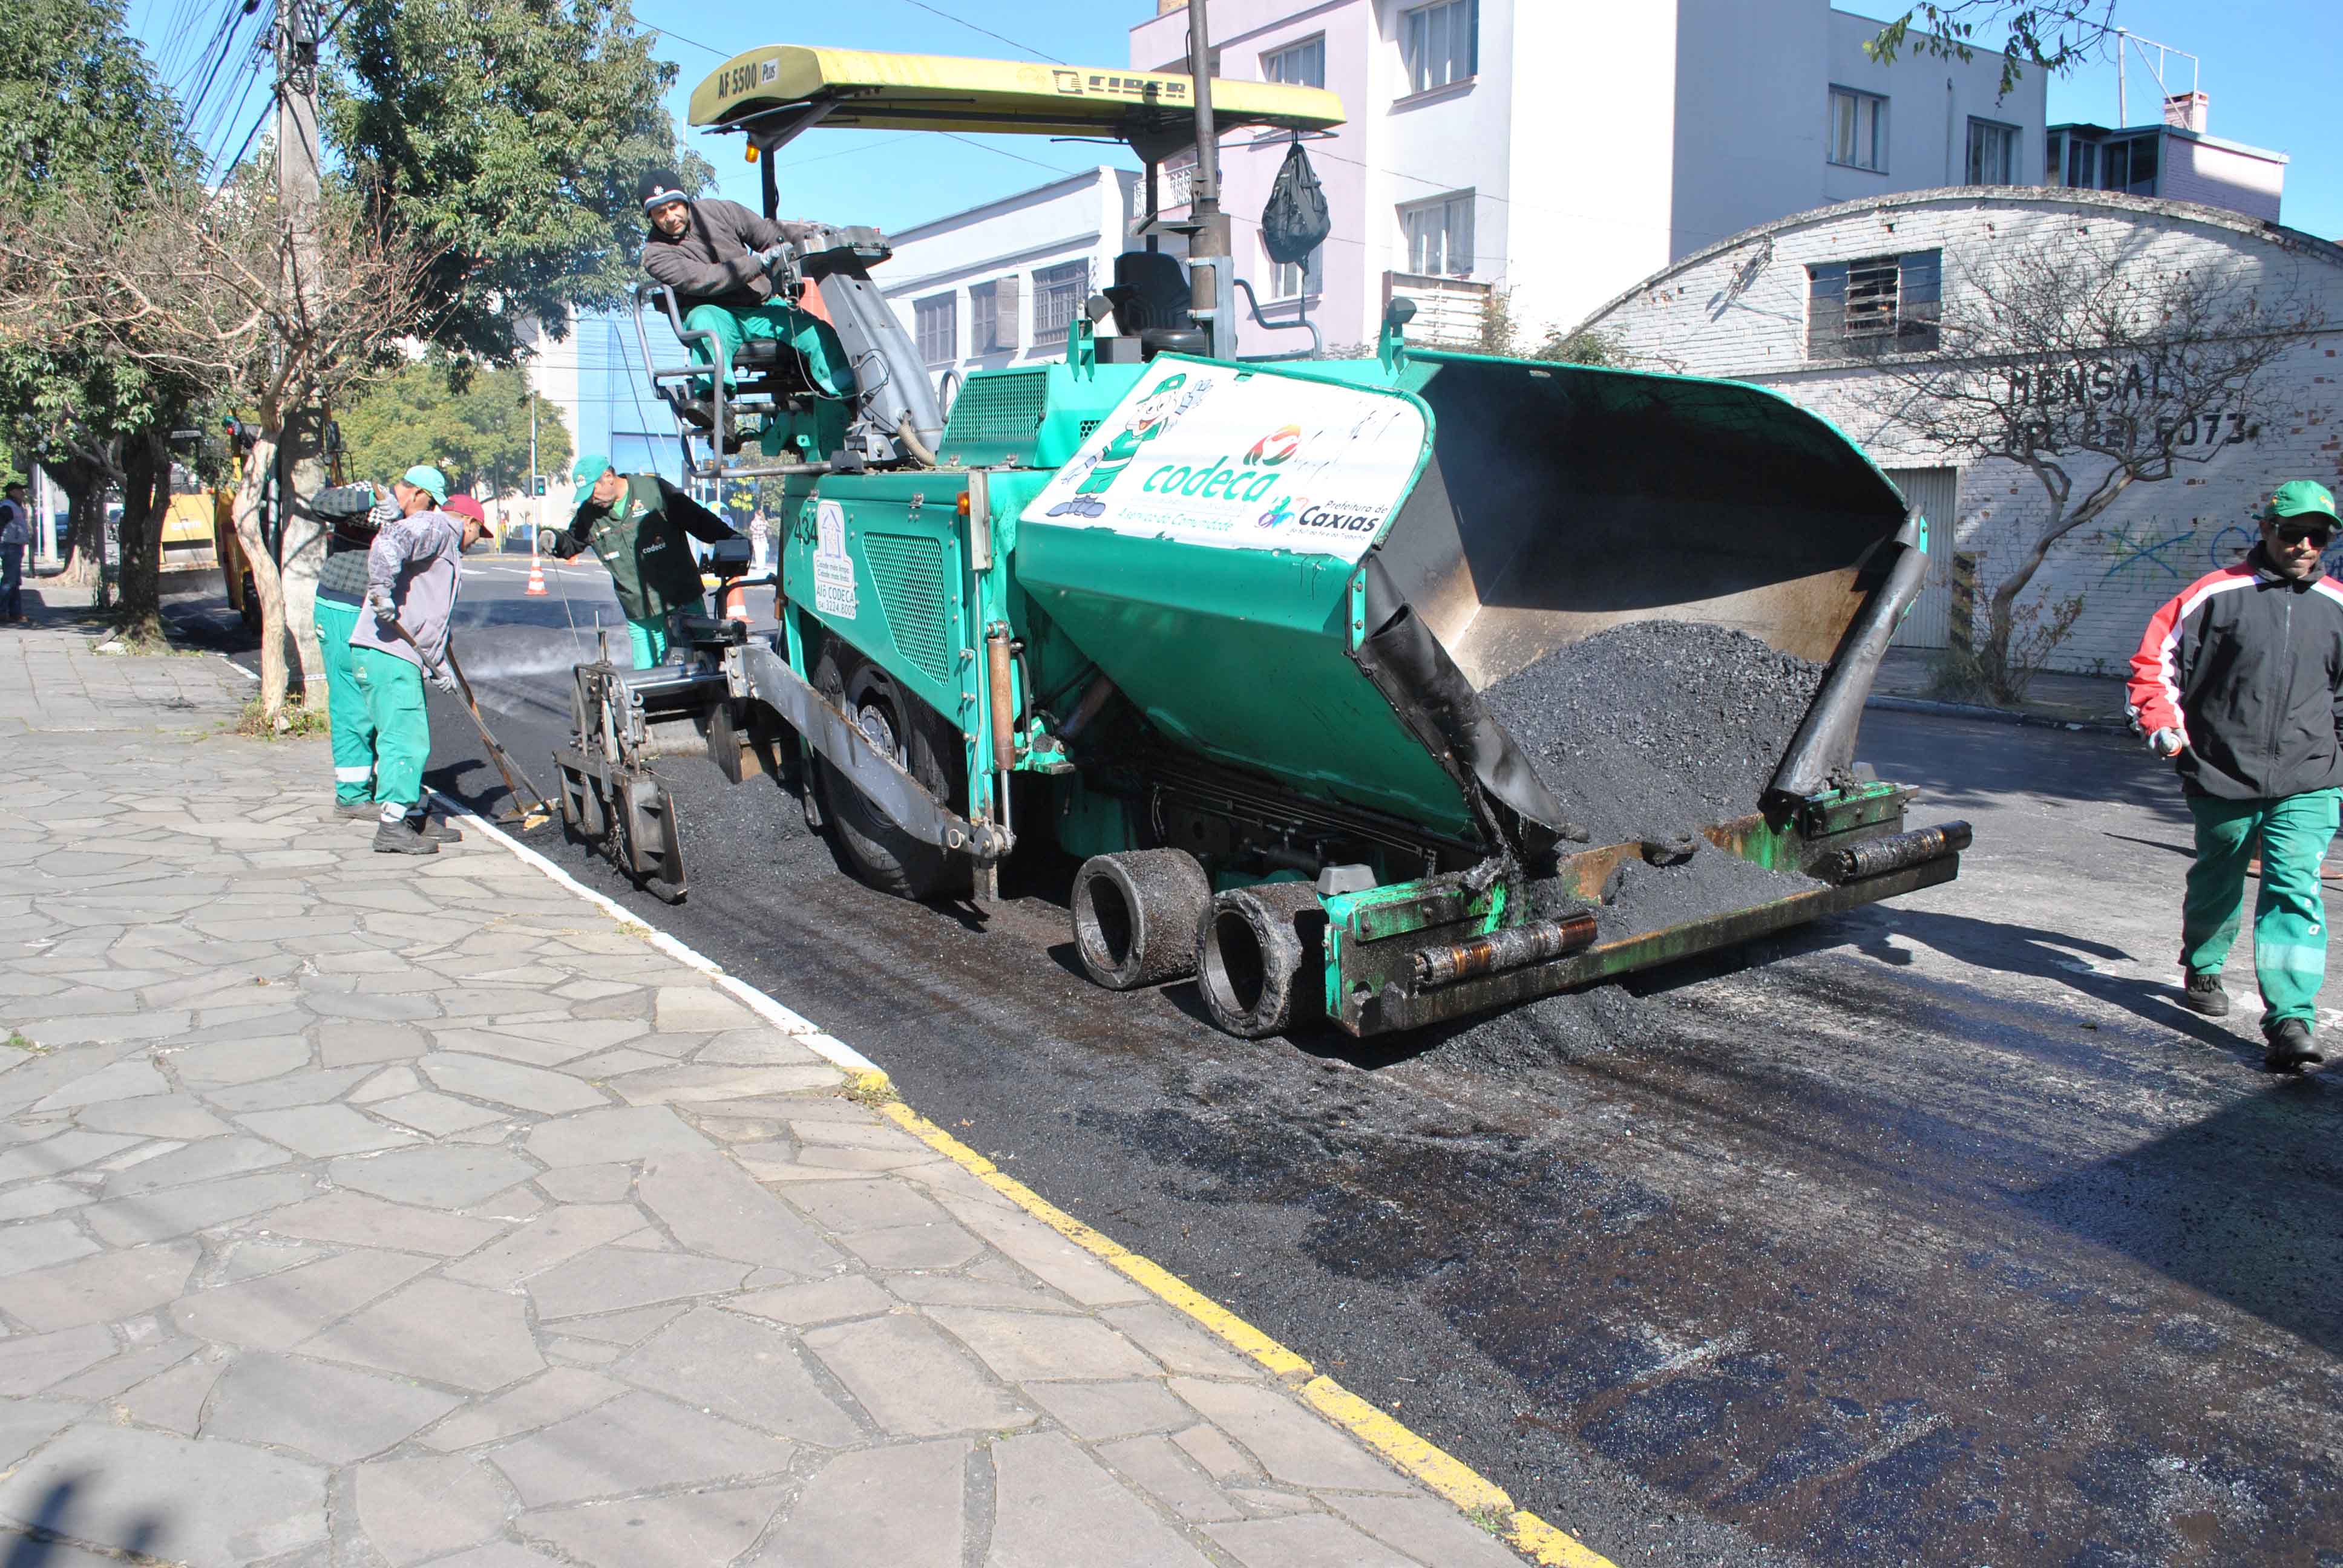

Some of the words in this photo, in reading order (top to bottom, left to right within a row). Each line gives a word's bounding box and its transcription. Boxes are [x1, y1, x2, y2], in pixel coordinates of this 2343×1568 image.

[718, 71, 730, 100] AF
[732, 62, 757, 95] 5500
[1088, 75, 1187, 99] CIBER
[2009, 362, 2174, 405] MENSAL
[1142, 455, 1281, 503] codeca
[1299, 505, 1380, 532] Caxias
[1325, 500, 1371, 513] Prefeitura
[1374, 503, 1388, 514] de
[794, 515, 819, 546] 434
[828, 587, 855, 604] CODECA
